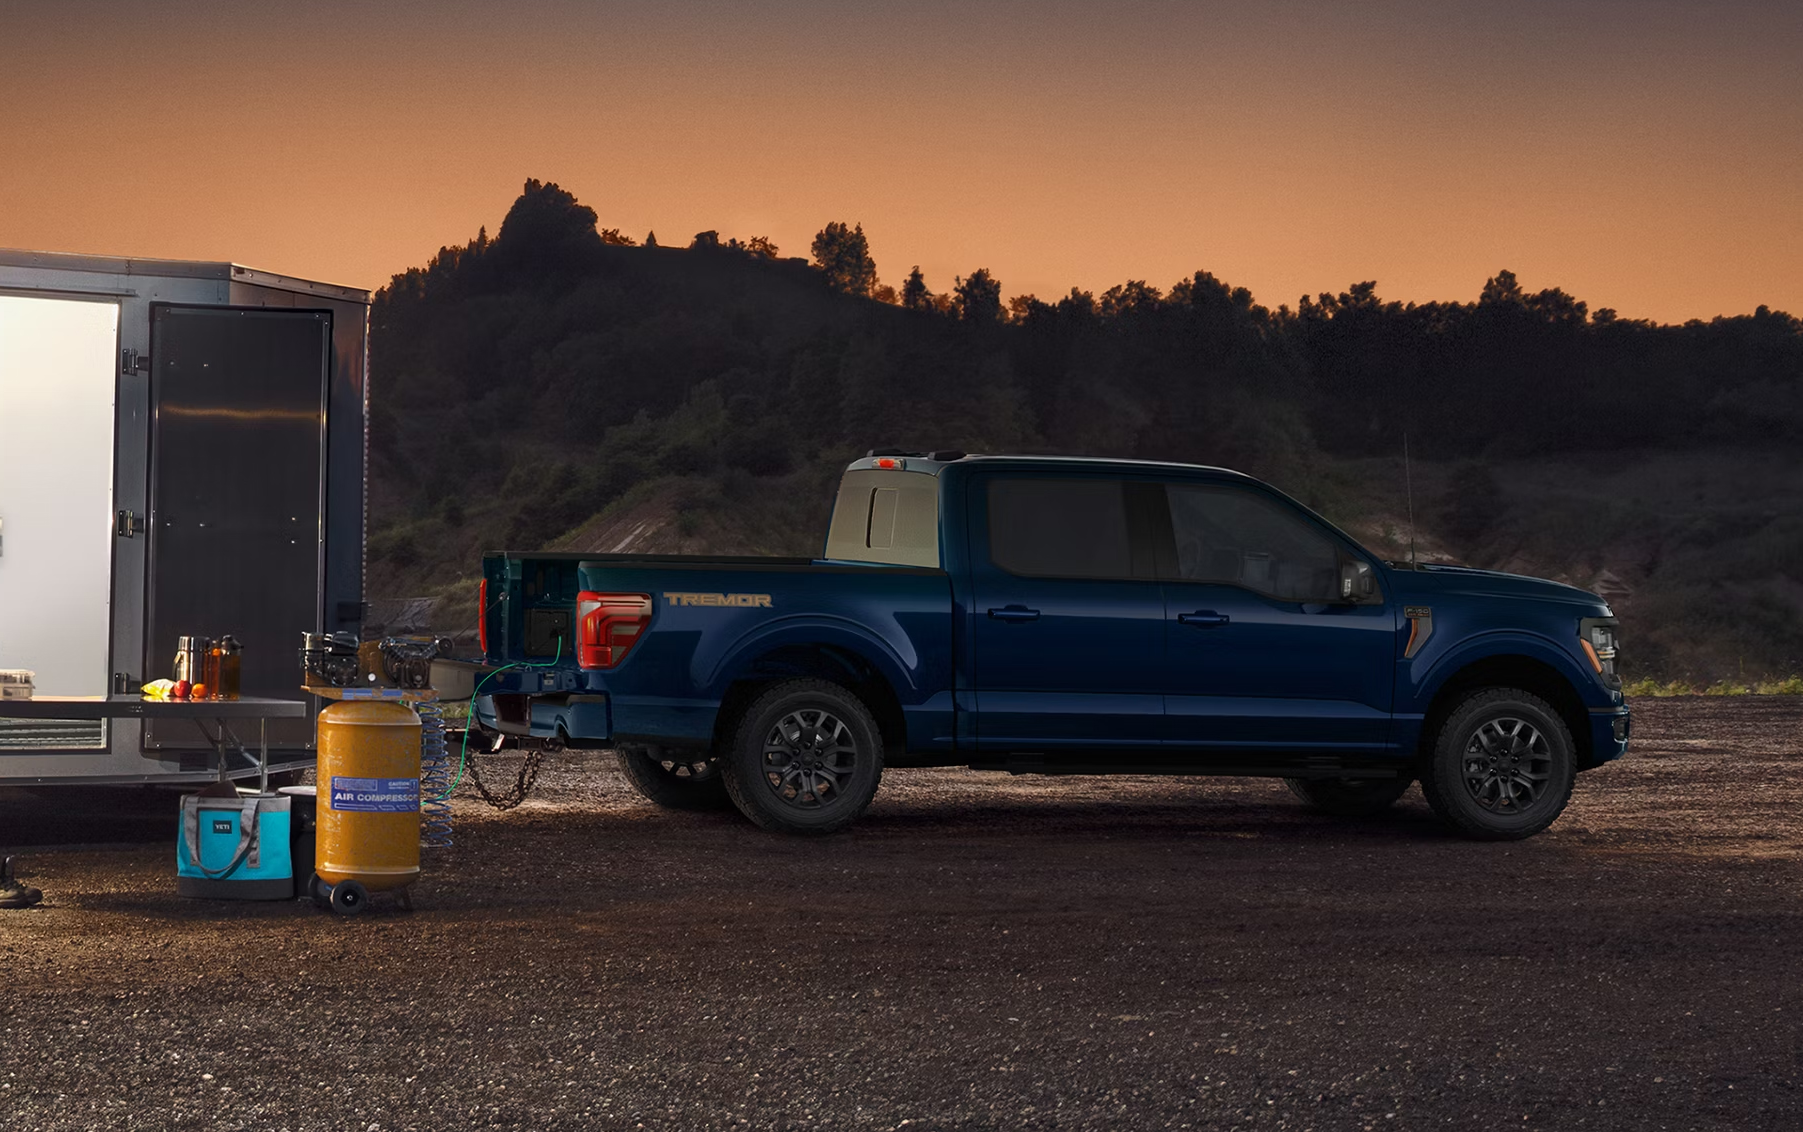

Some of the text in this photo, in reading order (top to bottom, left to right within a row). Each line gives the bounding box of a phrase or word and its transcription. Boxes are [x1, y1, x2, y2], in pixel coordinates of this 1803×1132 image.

[663, 592, 773, 607] TREMOR
[334, 792, 418, 802] AIR COMPRESSOR
